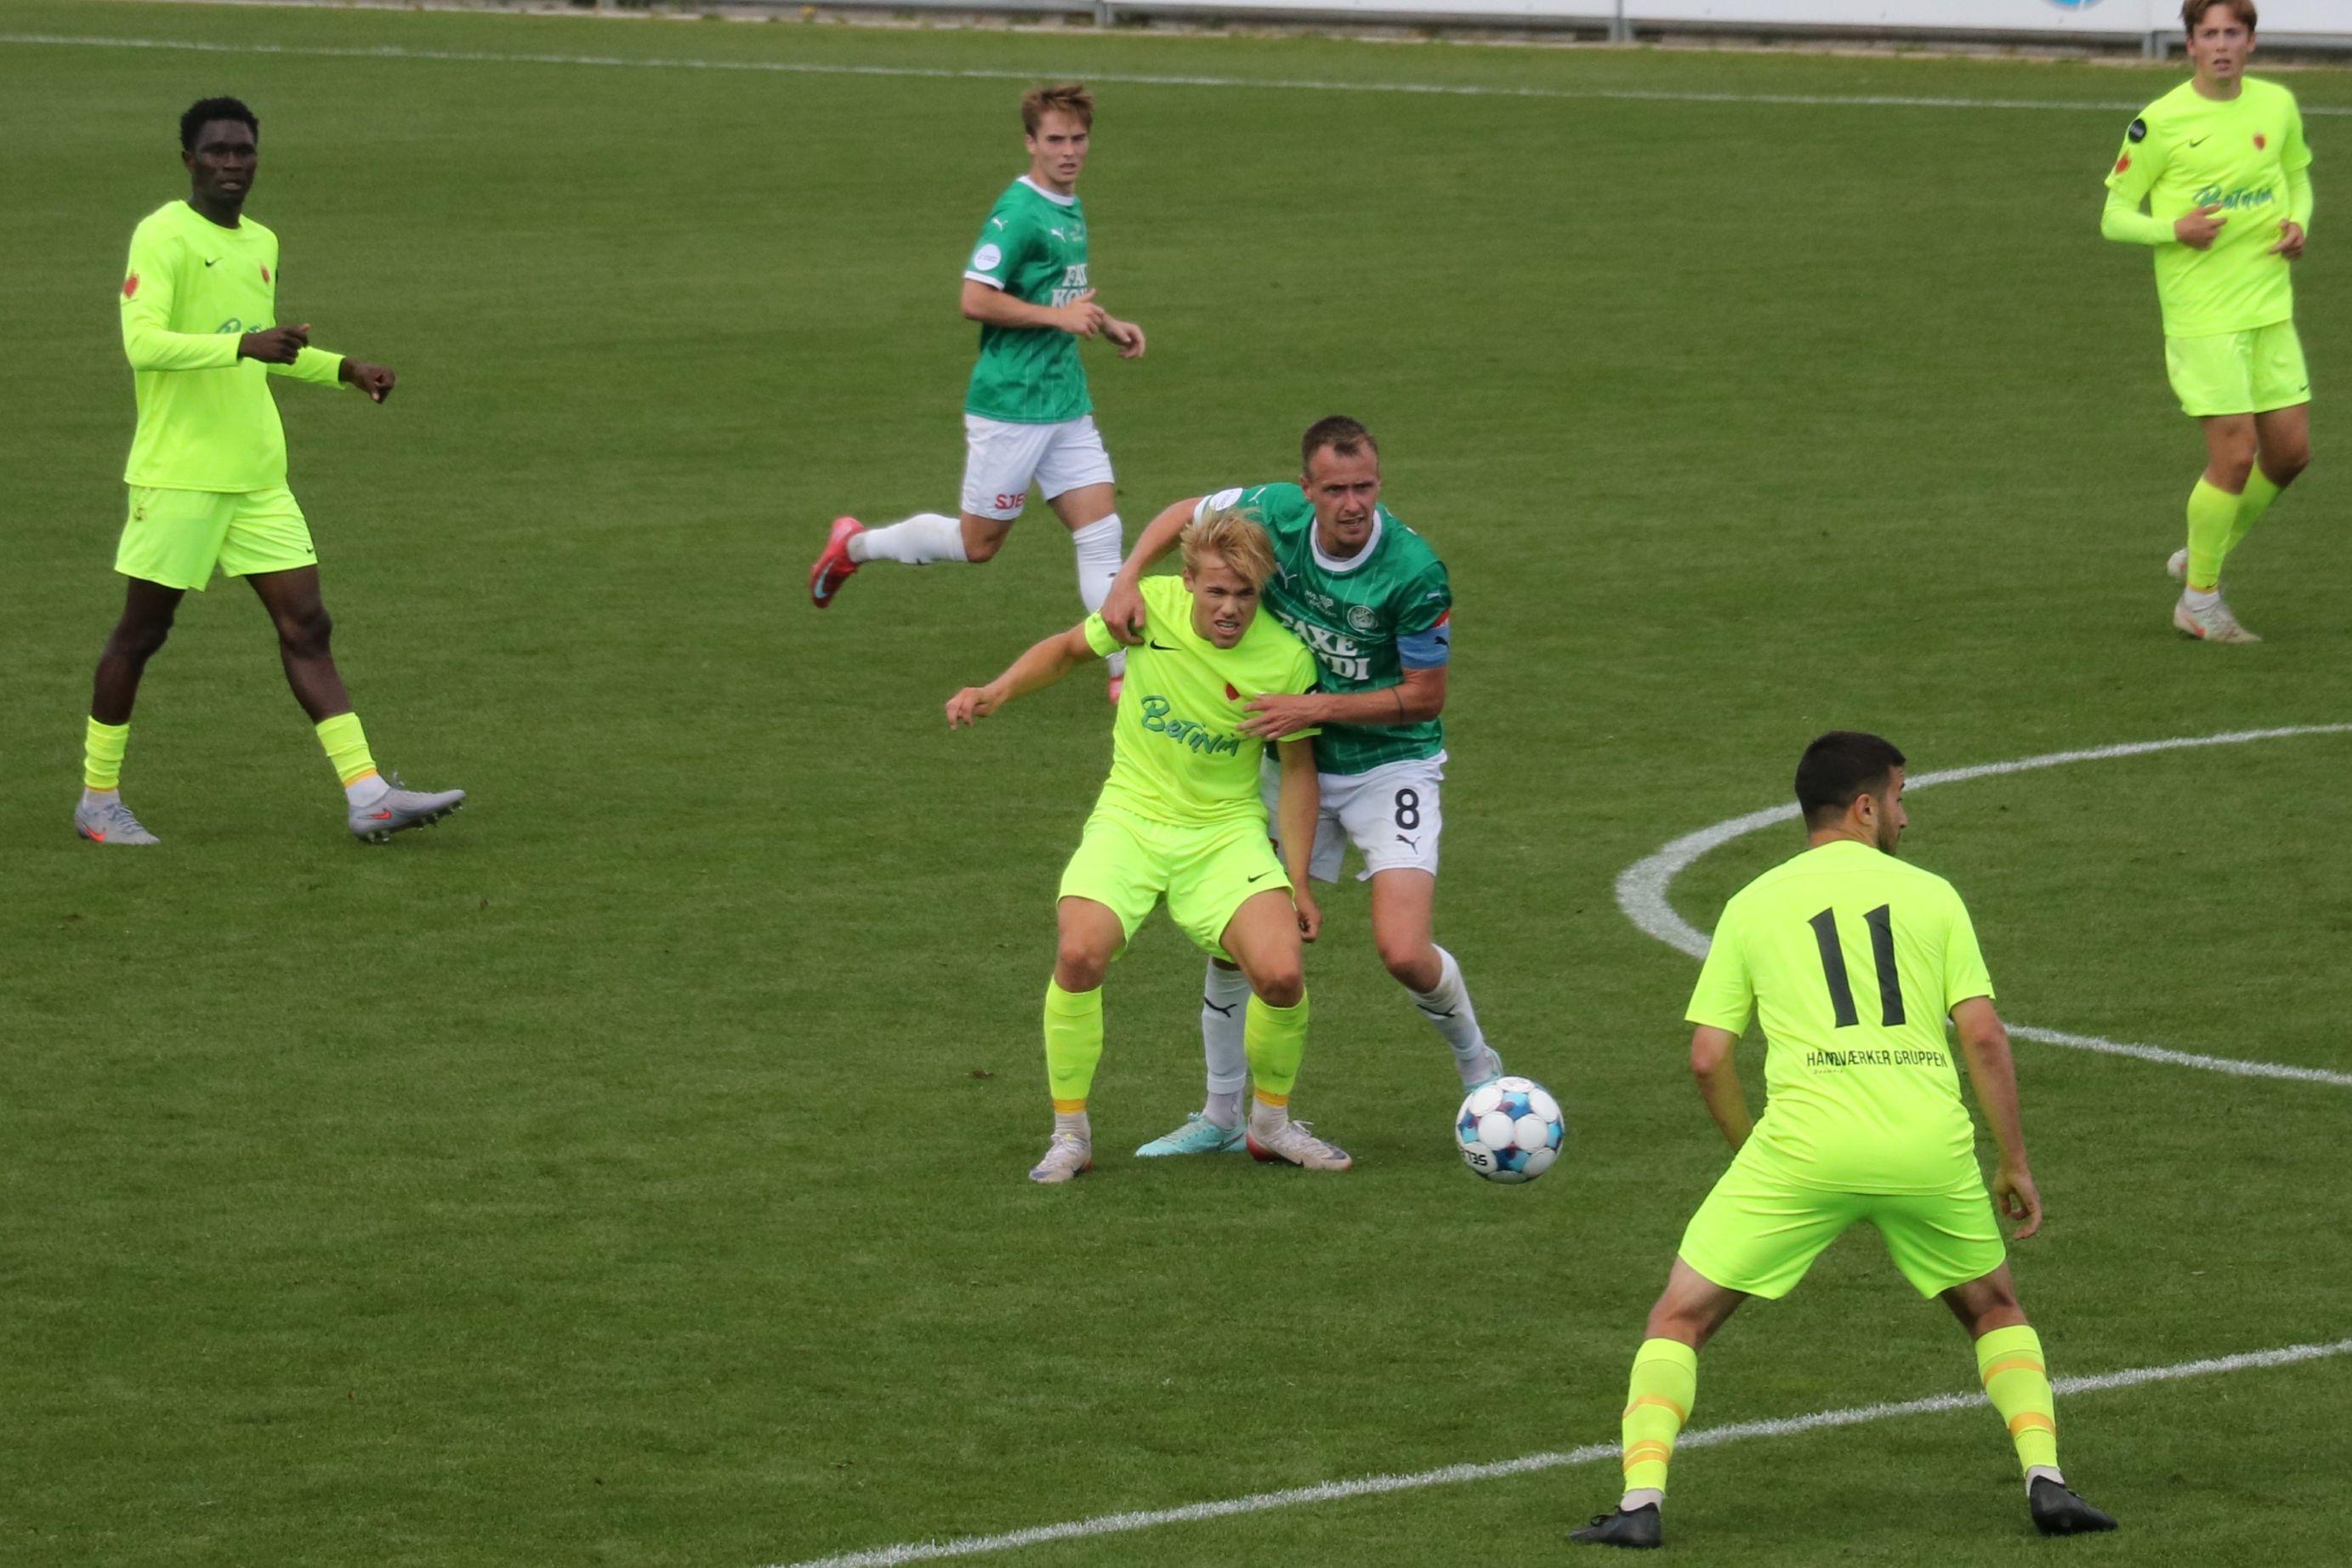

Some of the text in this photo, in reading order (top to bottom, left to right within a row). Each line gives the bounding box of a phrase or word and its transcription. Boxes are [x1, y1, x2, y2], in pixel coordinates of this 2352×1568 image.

[1395, 788, 1419, 830] 8
[1807, 904, 1906, 1028] 11
[1894, 1050, 1947, 1068] GRUPPEN
